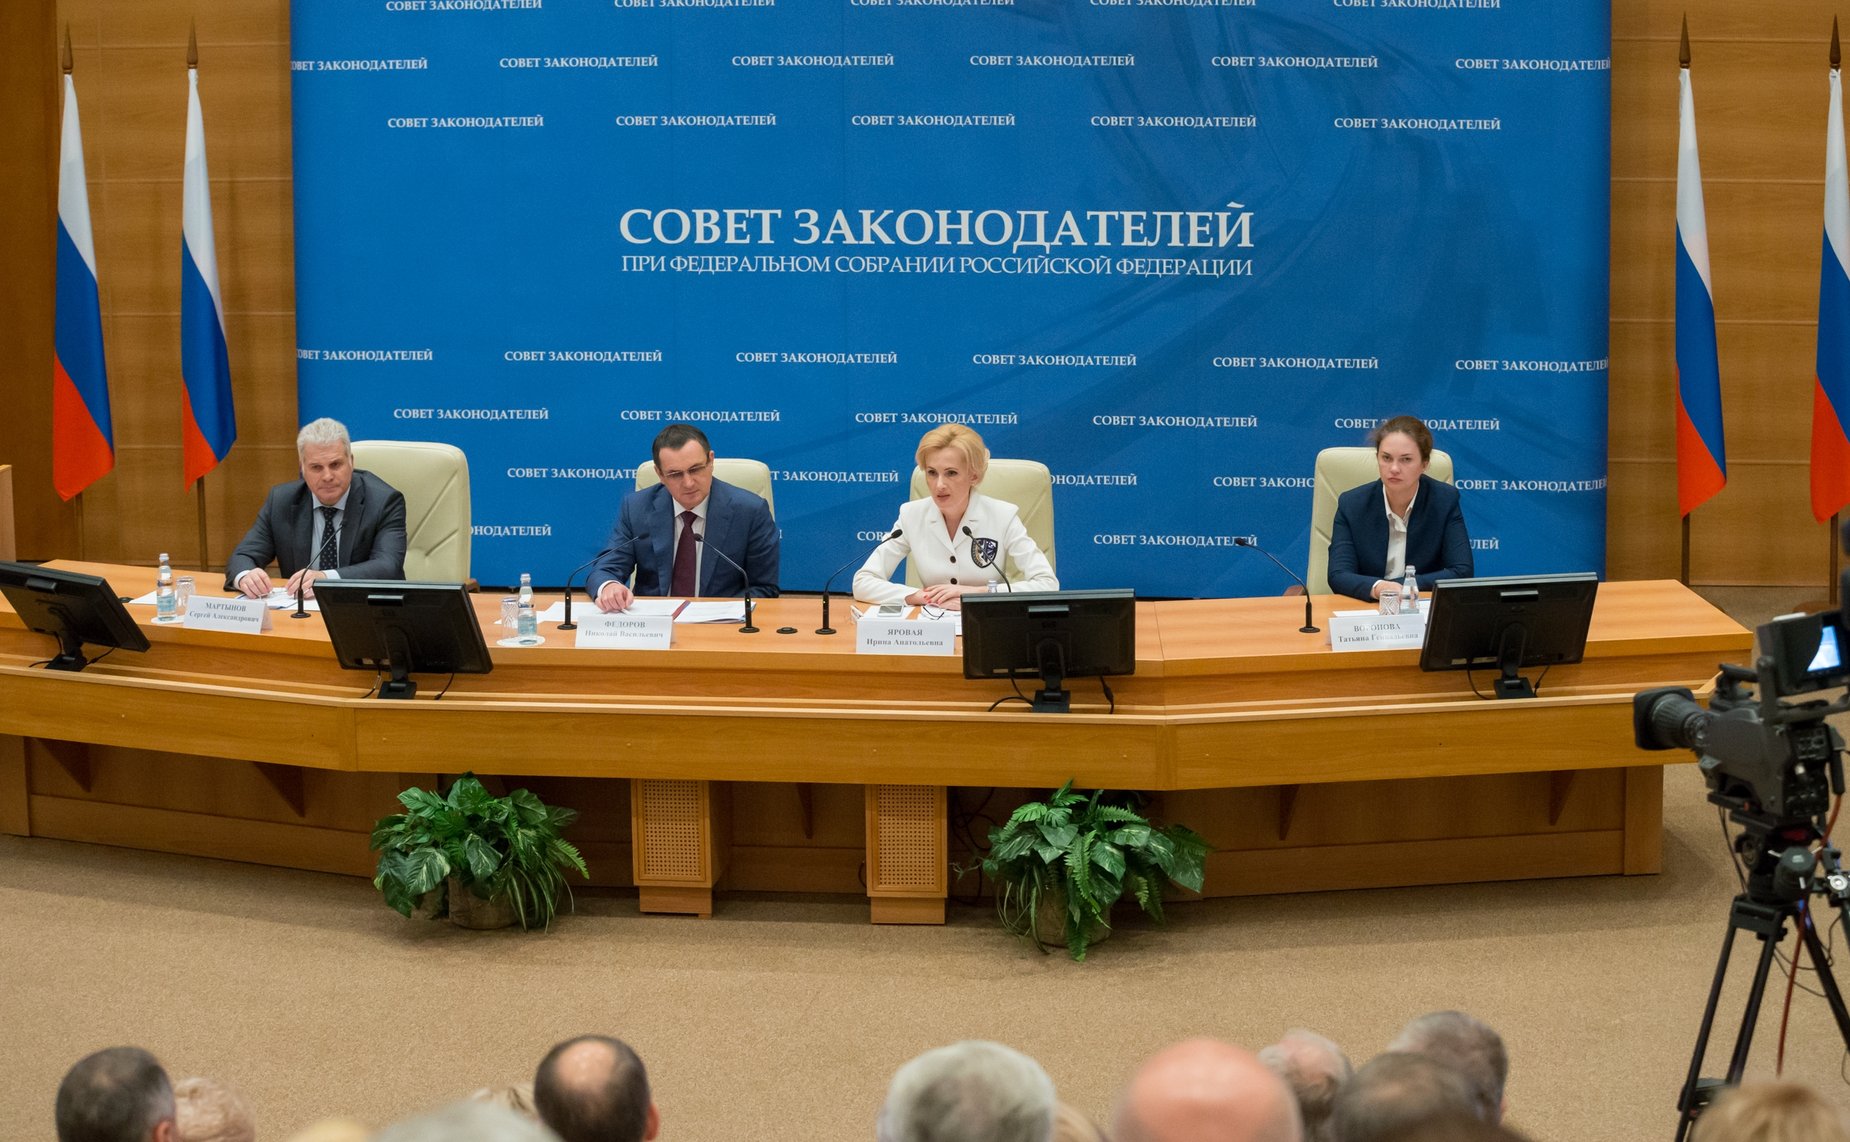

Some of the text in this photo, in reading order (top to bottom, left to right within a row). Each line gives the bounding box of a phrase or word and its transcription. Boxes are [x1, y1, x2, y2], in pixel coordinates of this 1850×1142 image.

[385, 0, 542, 11] СОВЕТ ЗАКОНОДАТЕЛЕЙ
[290, 57, 429, 72] ОВЕТ ЗАКОНОДАТЕЛЕЙ
[499, 55, 659, 69] СОВЕТ ЗАКОНОДАТЕЛЕЙ
[732, 53, 895, 67] СОВЕТ ЗАКОНОДАТЕЛЕЙ
[970, 53, 1136, 67] СОВЕТ ЗАКОНОДАТЕЛЕЙ
[1211, 55, 1379, 69] СОВЕТ ЗАКОНОДАТЕЛЕЙ
[1455, 58, 1501, 70] СОВЕТ
[387, 114, 545, 129] СОВЕТ ЗАКОНОДАТЕЛЕЙ
[616, 112, 777, 127] СОВЕТ ЗАКОНОДАТЕЛЕЙ
[852, 112, 1016, 127] СОВЕТ ЗАКОНОДАТЕЛЕЙ
[1091, 114, 1257, 129] СОВЕТ ЗАКОНОДАТЕЛЕЙ
[1334, 116, 1502, 131] СОВЕТ ЗАКОНОДАТЕЛЕЙ
[619, 201, 1255, 253] СОВЕТ ЗАКОНОДАТЕЛЕЙ
[622, 253, 1254, 279] ПРИ ФЕДЕРАЛЬНОМ СОБРАНИИ РОССИЙСКОЙ ФЕДЕРАЦИИ
[297, 348, 434, 362] ОВЕТ ЗАКОНОДАТЕЛЕЙ
[504, 349, 663, 363] СОВЕТ ЗАКОНОДАТЕЛЕЙ
[736, 350, 898, 365] СОВЕТ ЗАКОНОДАТЕЛЕЙ
[973, 352, 1137, 368] СОВЕТ ЗАКОНОДАТЕЛЕЙ
[1212, 356, 1379, 371] СОВЕТ ЗАКОНОДАТЕЛЕЙ
[1455, 359, 1500, 371] СОВЕТ
[393, 407, 550, 421] СОВЕТ ЗАКОНОДАТЕЛЕЙ
[620, 408, 781, 423] СОВЕТ ЗАКОНОДАТЕЛЕЙ
[855, 411, 1018, 427] СОВЕТ ЗАКОНОДАТЕЛЕЙ
[1092, 413, 1258, 429] СОВЕТ ЗАКОНОДАТЕЛЕЙ
[1334, 417, 1379, 429] СОВЕТ
[507, 467, 638, 481] СОВЕТ ЗАКОНОДАТЕ
[782, 469, 899, 484] ЗАКОНОДАТЕЛЕЙ
[1213, 476, 1258, 488] СОВЕТ
[1455, 479, 1499, 491] СОВЕТ
[471, 523, 552, 538] НОДАТЕЛЕЙ
[1094, 534, 1138, 545] СОВЕТ
[205, 602, 247, 612] МАРТЫНОВ
[1353, 624, 1401, 632] ВООНОВА
[866, 638, 891, 647] Ирина
